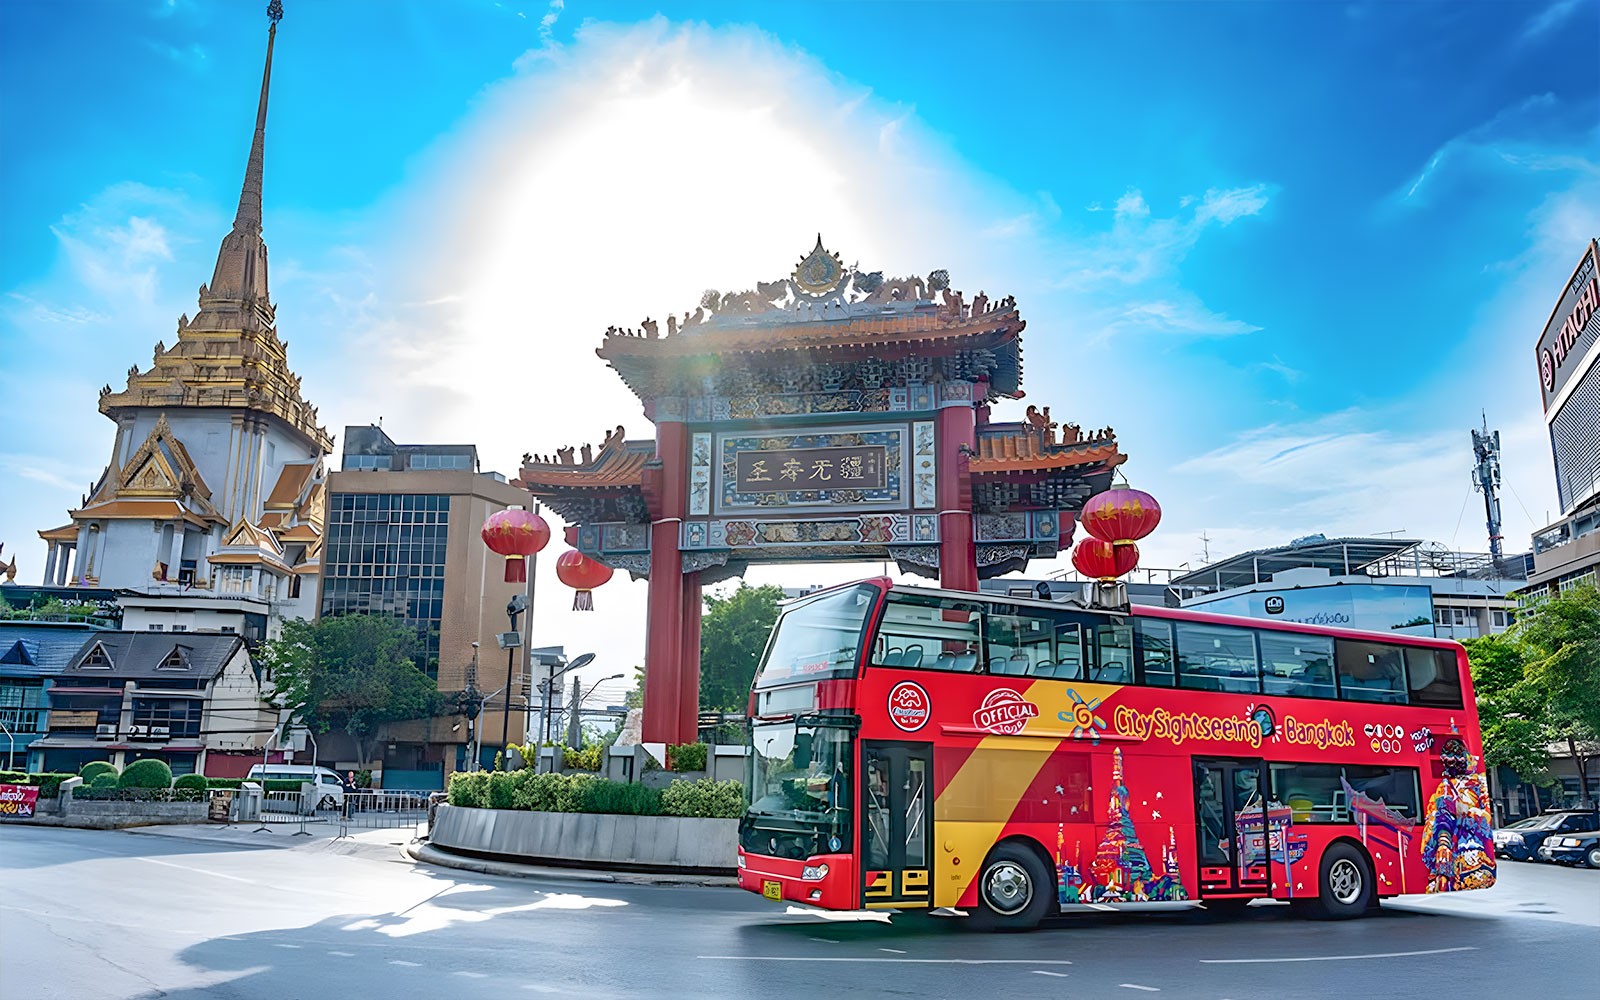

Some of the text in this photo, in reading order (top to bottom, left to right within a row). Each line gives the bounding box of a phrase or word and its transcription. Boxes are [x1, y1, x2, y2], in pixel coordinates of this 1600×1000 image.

[1553, 278, 1598, 368] HITACHI
[980, 704, 1036, 726] OFFICIAL
[1284, 715, 1355, 750] Bangkok
